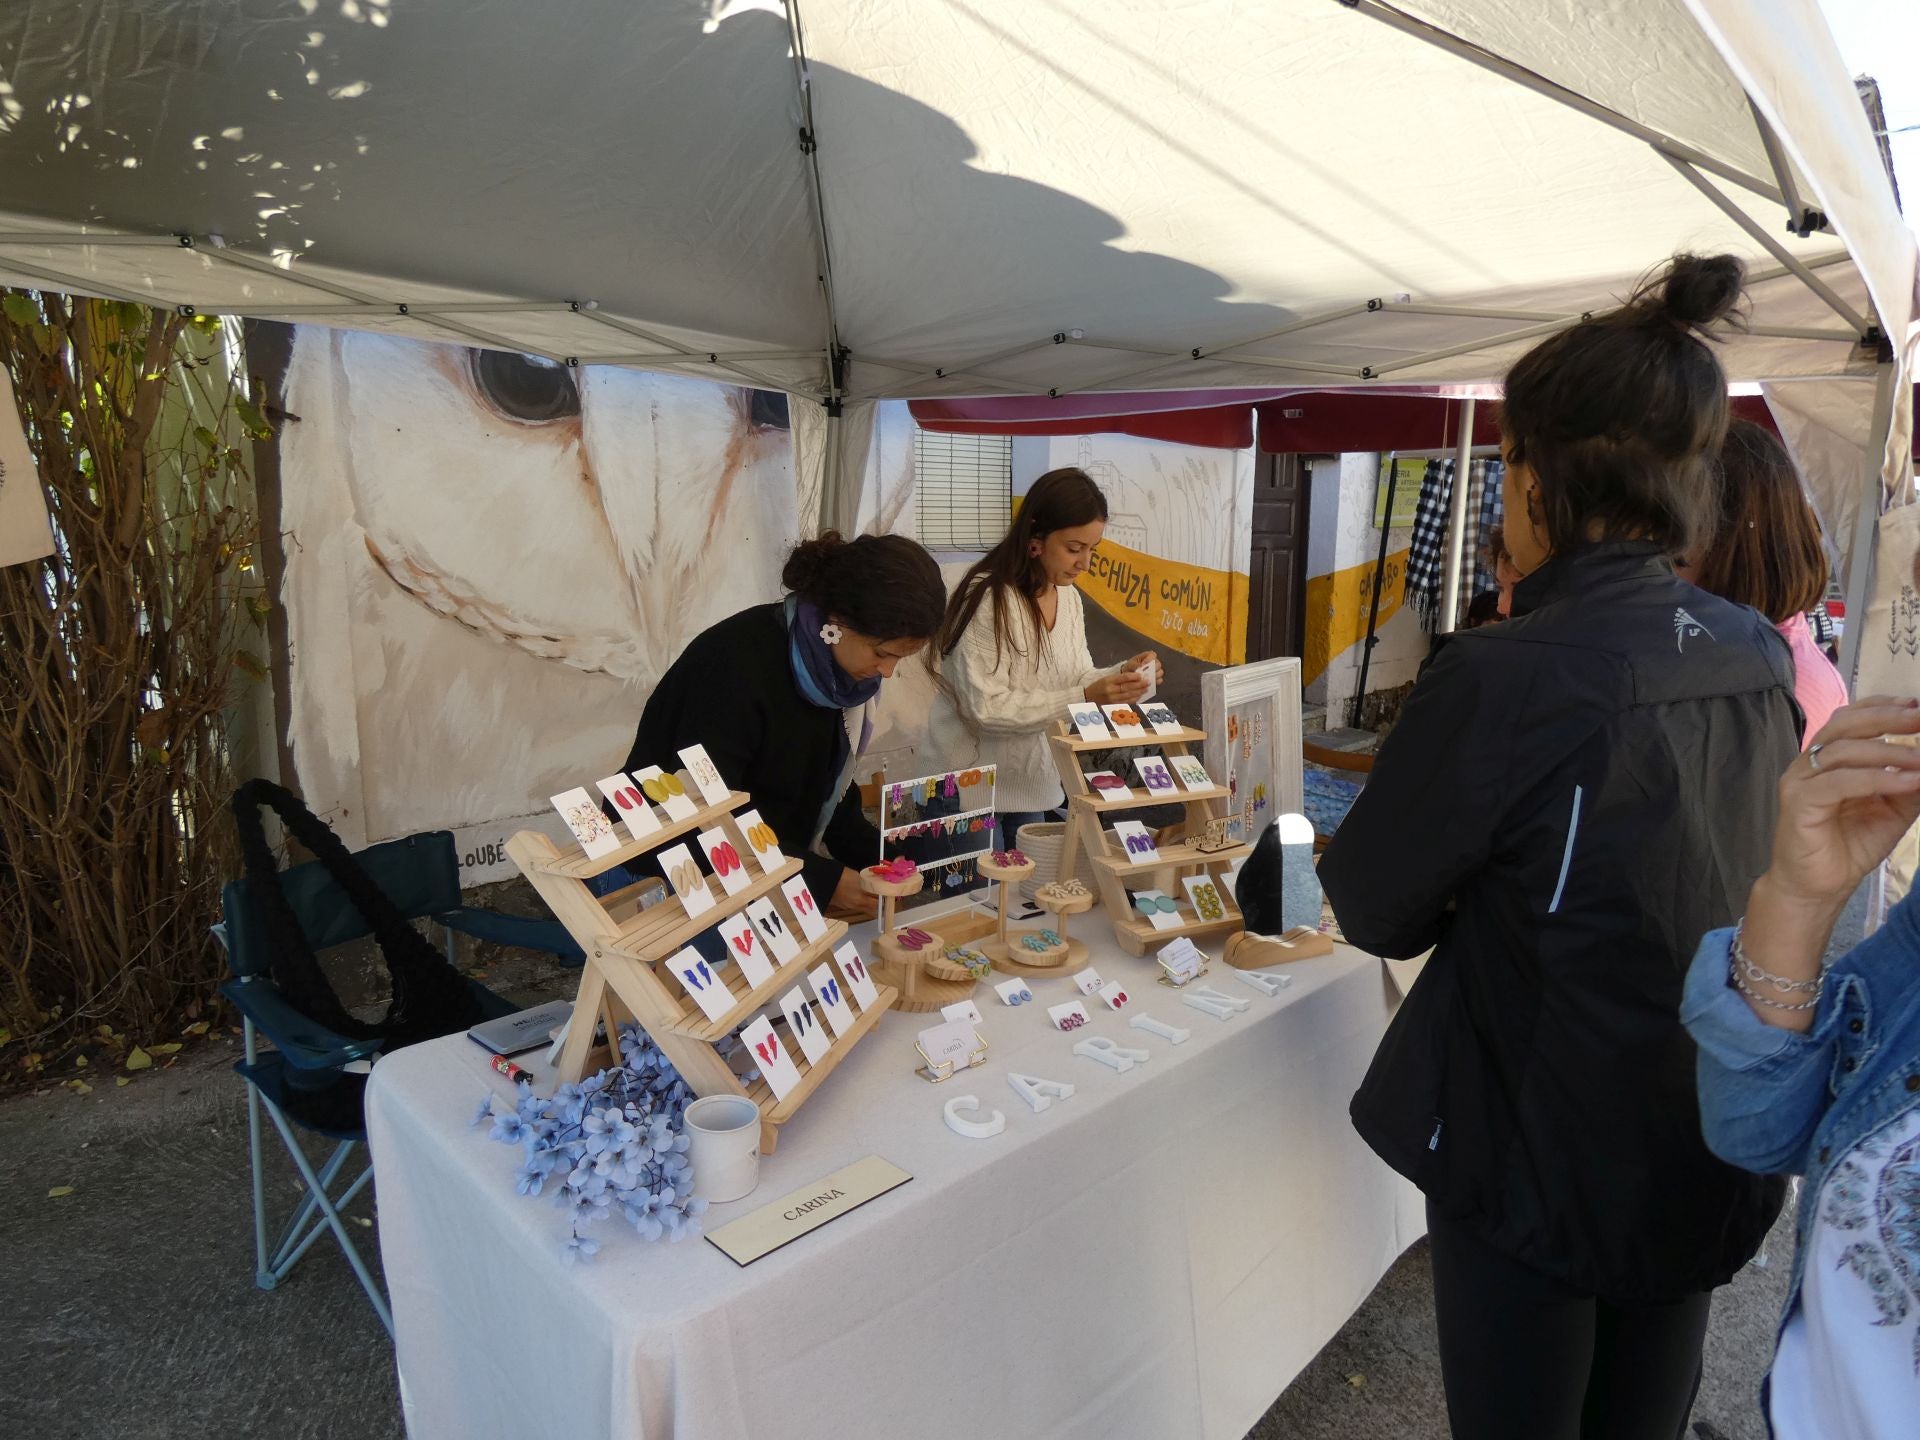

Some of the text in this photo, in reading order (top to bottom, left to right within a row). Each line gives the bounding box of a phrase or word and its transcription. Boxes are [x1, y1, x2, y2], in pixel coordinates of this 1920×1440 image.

[1088, 552, 1212, 611] ECHUZA COMÚN
[1188, 617, 1209, 638] alba
[783, 1188, 847, 1222] CARINA
